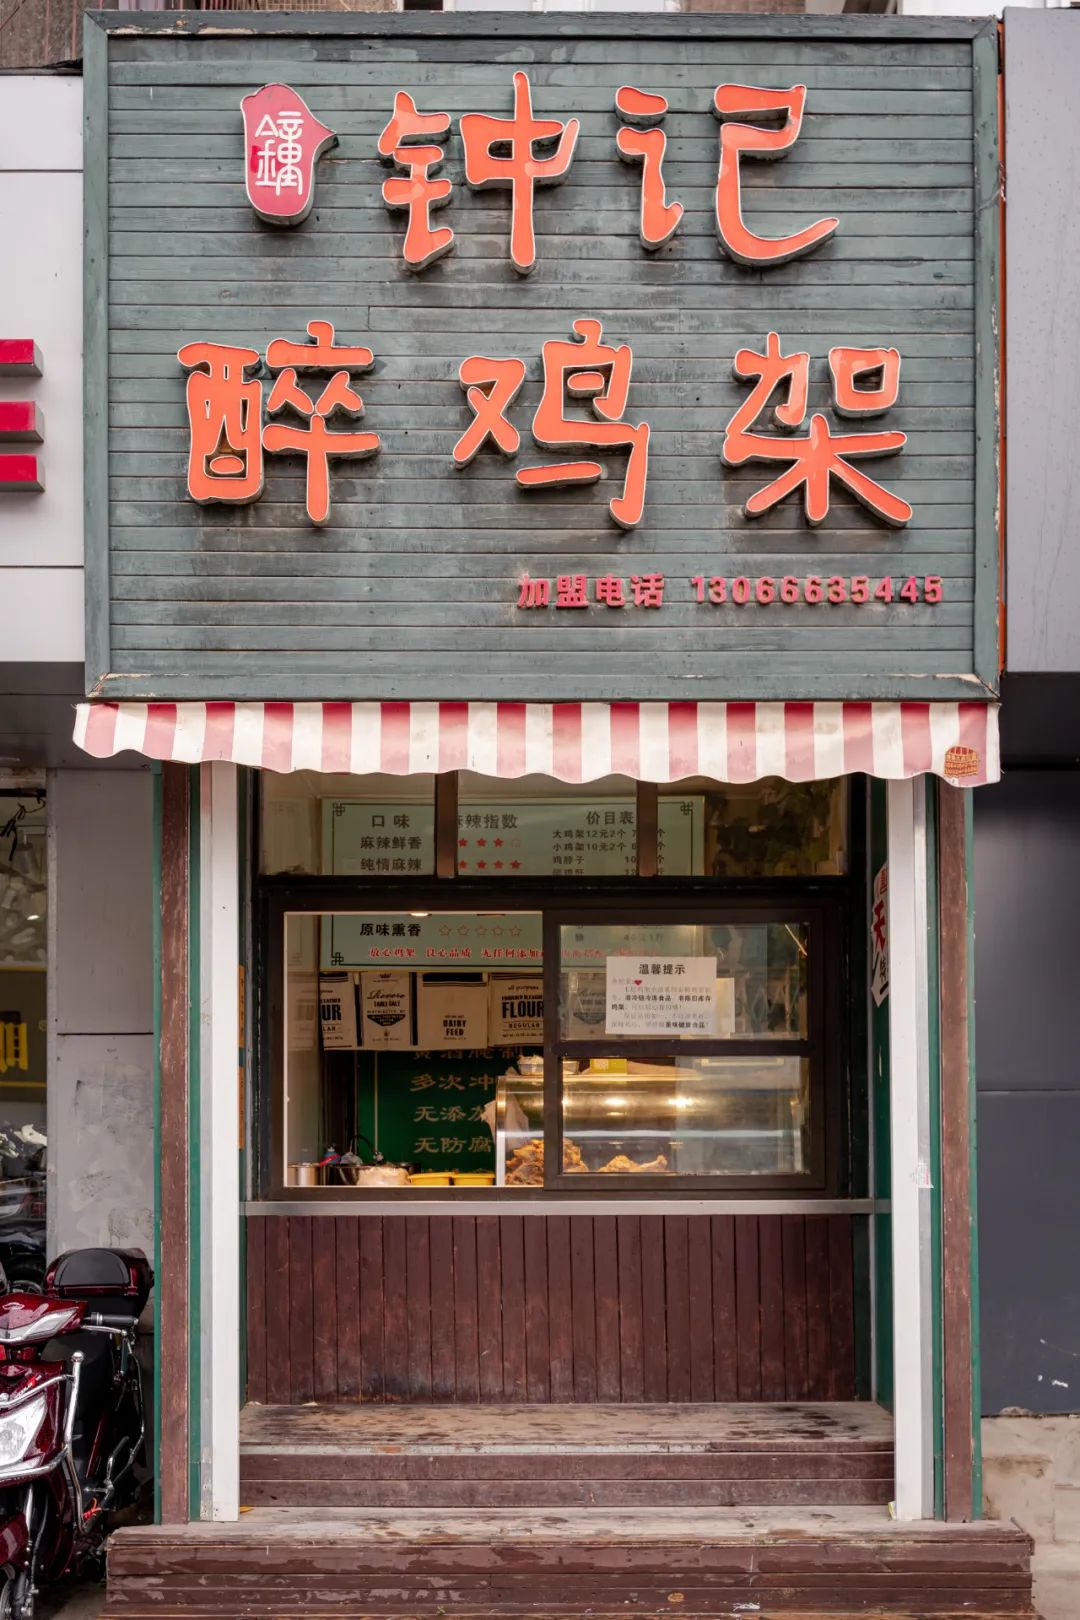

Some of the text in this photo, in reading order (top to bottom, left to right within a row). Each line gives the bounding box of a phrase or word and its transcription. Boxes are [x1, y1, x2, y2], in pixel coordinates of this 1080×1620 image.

[377, 70, 840, 272] 钟记
[177, 318, 914, 526] 醉鸡架
[517, 574, 945, 609] 加盟电话 13066635445
[372, 813, 410, 829] 口味
[586, 811, 635, 825] 价目表
[360, 836, 422, 850] 麻辣鲜香
[360, 923, 422, 937] 原味熏香
[481, 947, 543, 959] 无任何添加
[639, 963, 686, 975] 温馨提示
[502, 1001, 544, 1018] FLOUR
[443, 1019, 467, 1028] DAIRY
[445, 1028, 464, 1036] FEED
[410, 1073, 498, 1092] 多次冲
